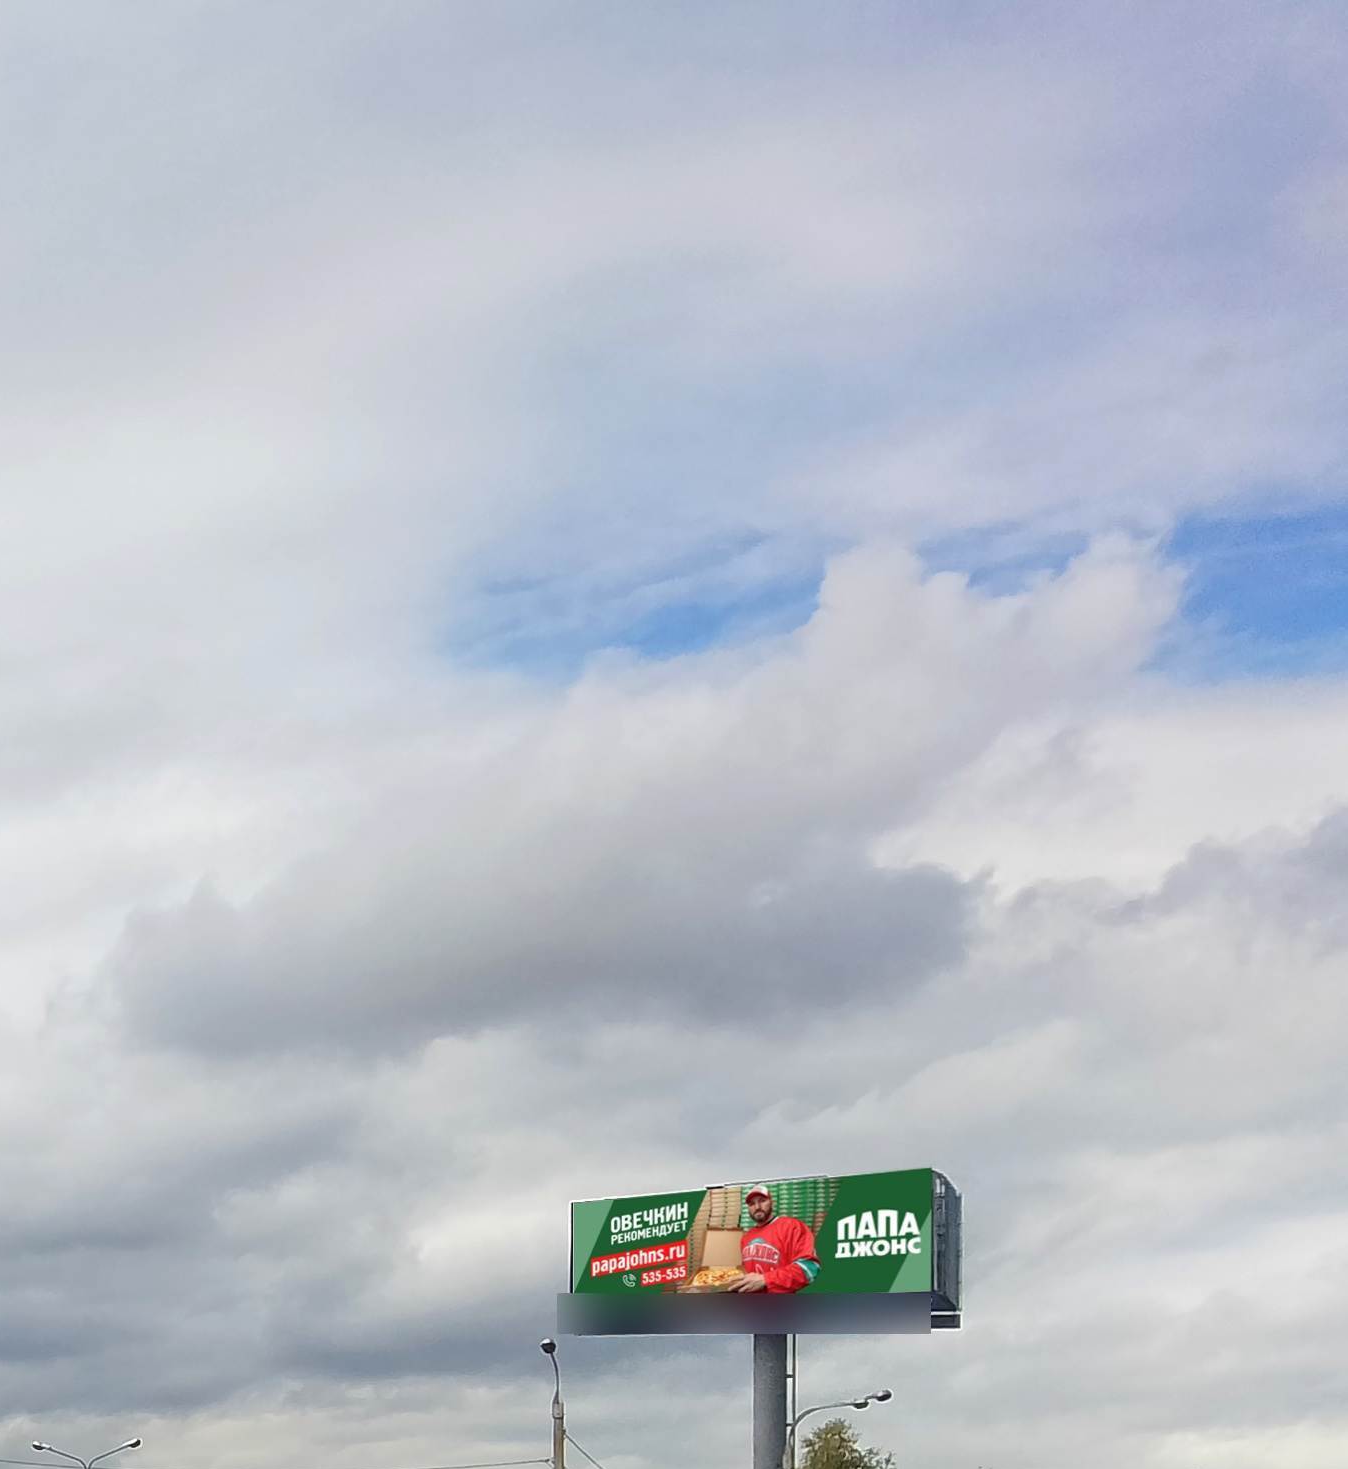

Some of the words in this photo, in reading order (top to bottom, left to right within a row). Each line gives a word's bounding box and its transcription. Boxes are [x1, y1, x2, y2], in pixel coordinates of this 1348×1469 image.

[610, 1201, 689, 1233] ОВЕЧКИН
[837, 1209, 921, 1240] ПАПА
[610, 1220, 688, 1245] РЕКОМЕНДУЕТ
[591, 1244, 686, 1277] papajohns.ru
[835, 1236, 922, 1259] ДЖОНС
[641, 1266, 687, 1284] 535-535
